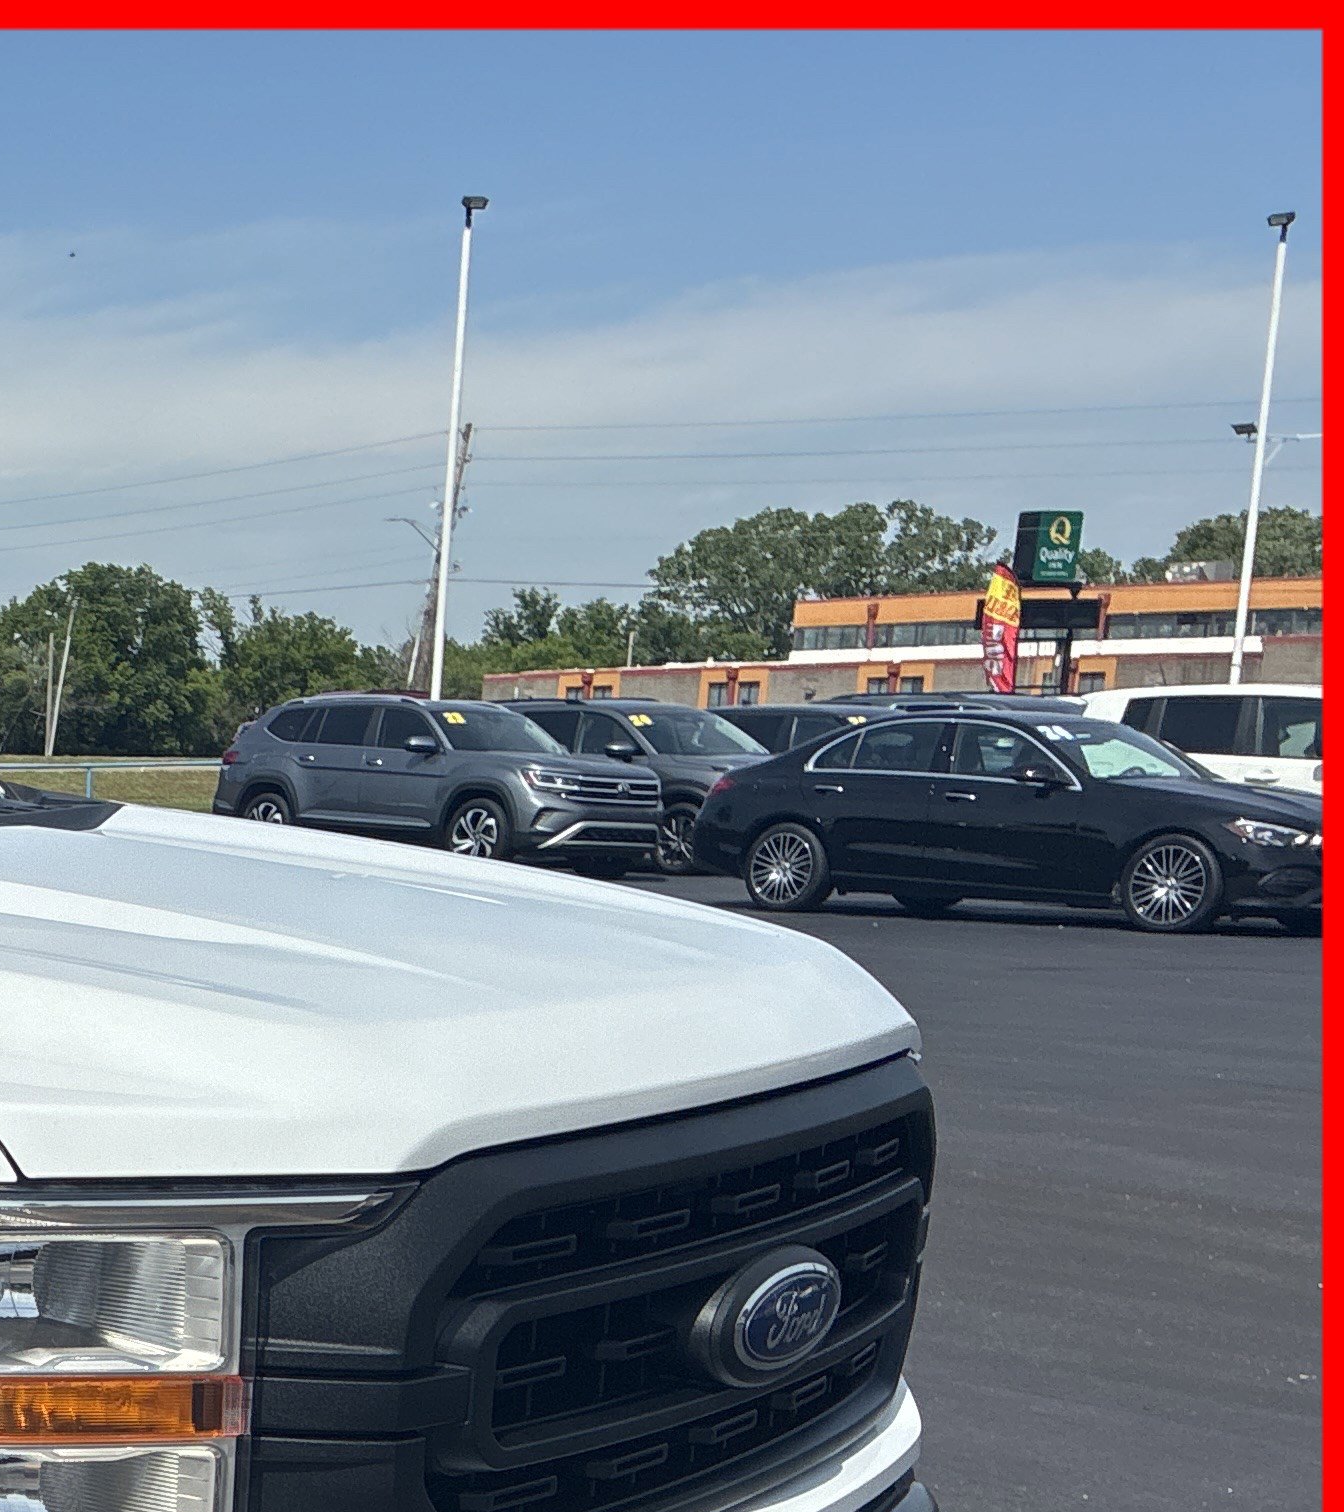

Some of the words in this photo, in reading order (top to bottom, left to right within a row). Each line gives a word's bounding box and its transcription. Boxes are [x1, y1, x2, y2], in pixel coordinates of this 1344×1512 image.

[1050, 516, 1071, 545] Q
[1039, 547, 1075, 564] Quality
[766, 1282, 828, 1351] Ford
